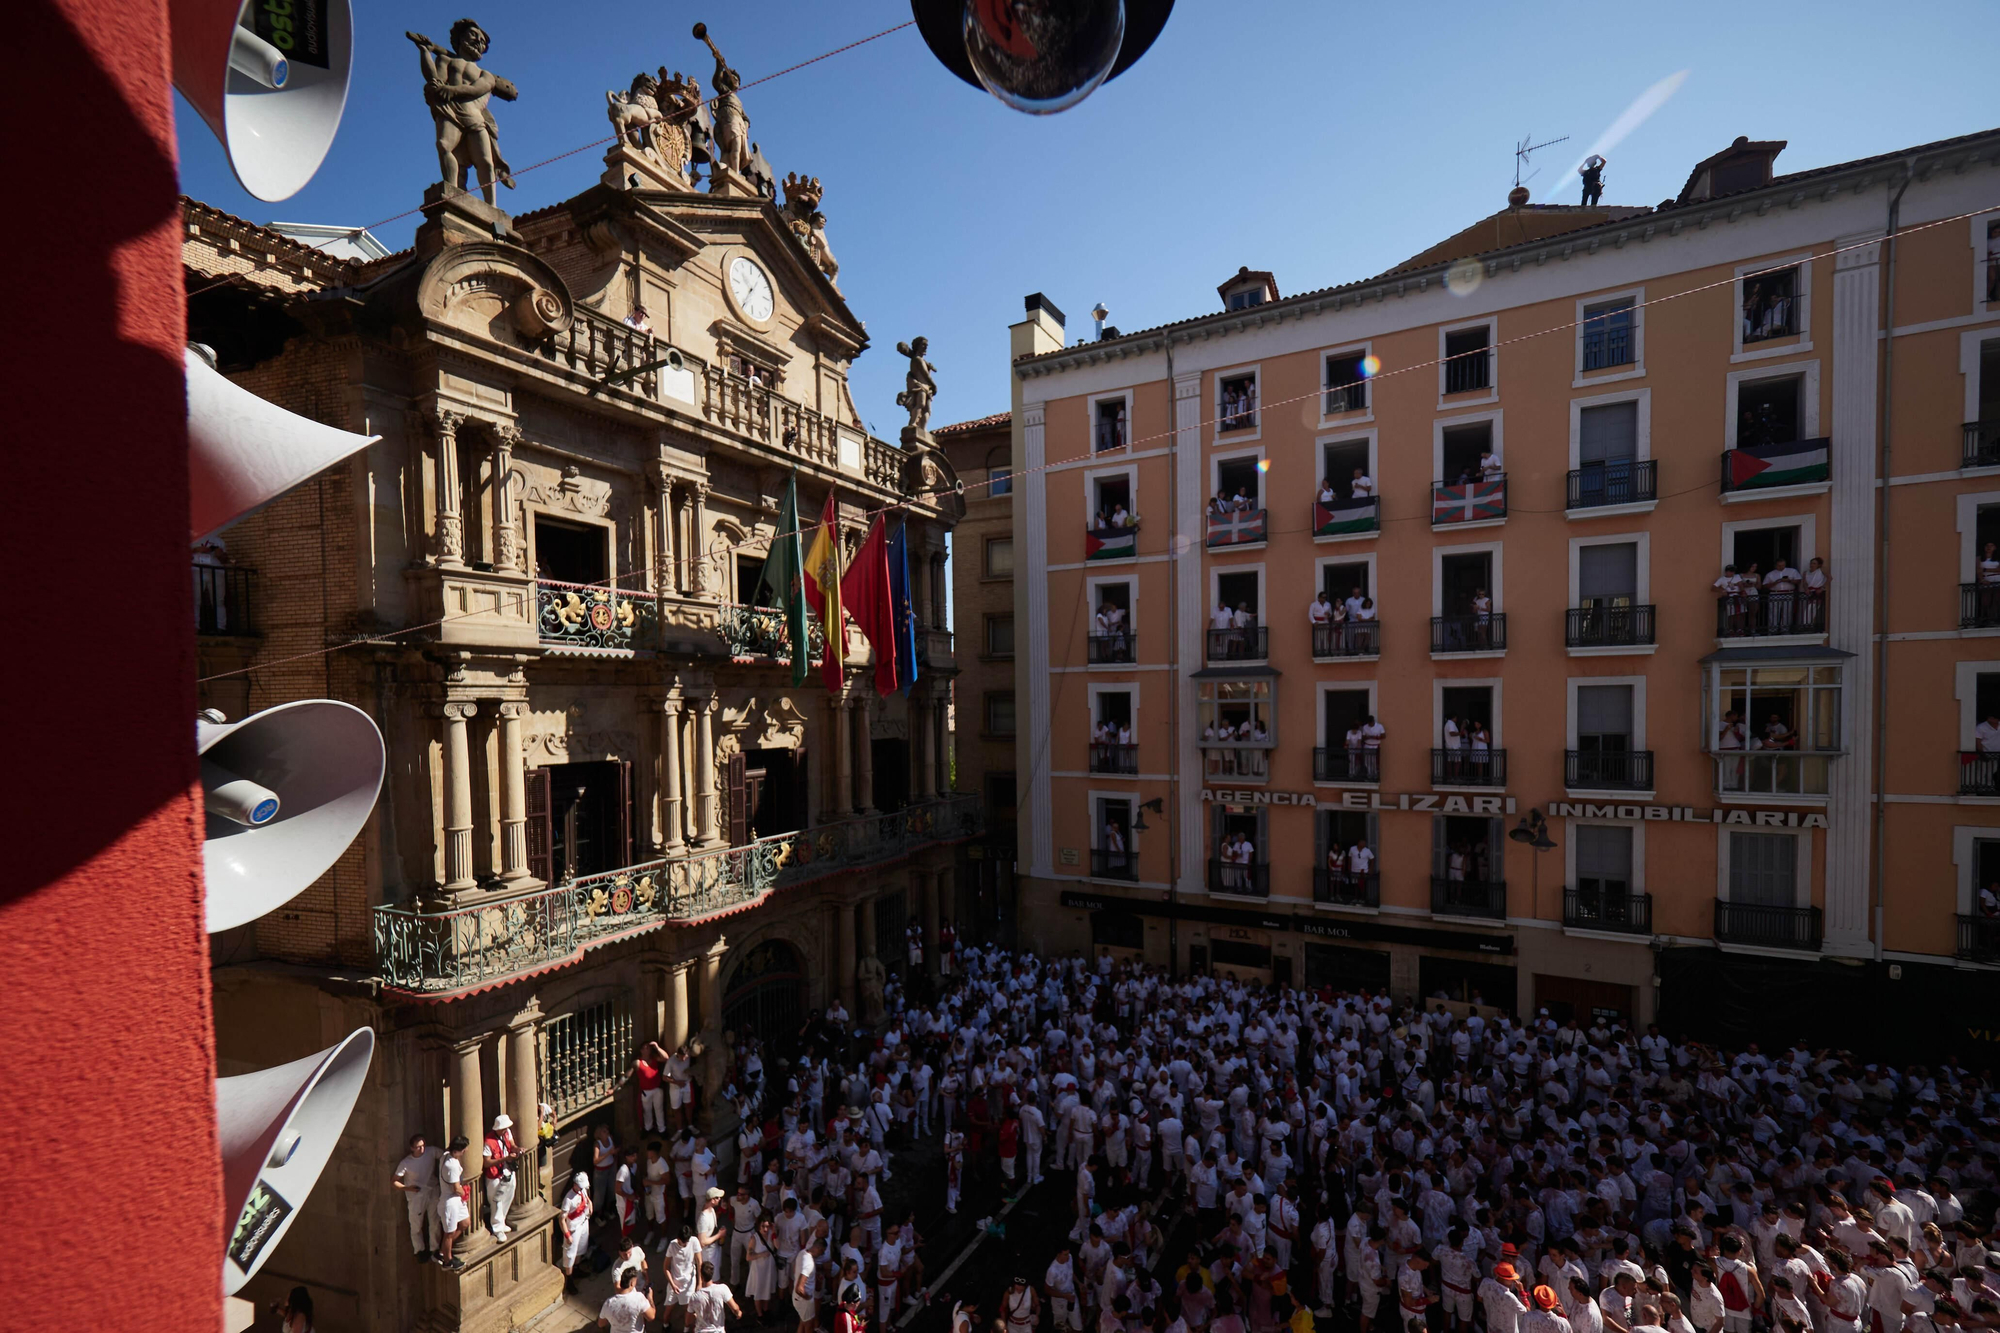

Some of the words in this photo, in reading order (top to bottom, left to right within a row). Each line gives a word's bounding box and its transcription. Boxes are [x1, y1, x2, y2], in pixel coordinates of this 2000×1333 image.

[264, 0, 294, 50] ost
[1200, 789, 1317, 807] AGENCIA
[1343, 792, 1516, 814] ELIZARI
[1548, 802, 1830, 828] INMOBILIARIA
[1068, 899, 1085, 908] BAR
[1086, 901, 1104, 910] MOL
[1229, 928, 1251, 940] MOL
[1304, 924, 1325, 935] BAR
[1327, 927, 1351, 938] MOL
[1584, 963, 1592, 973] 2
